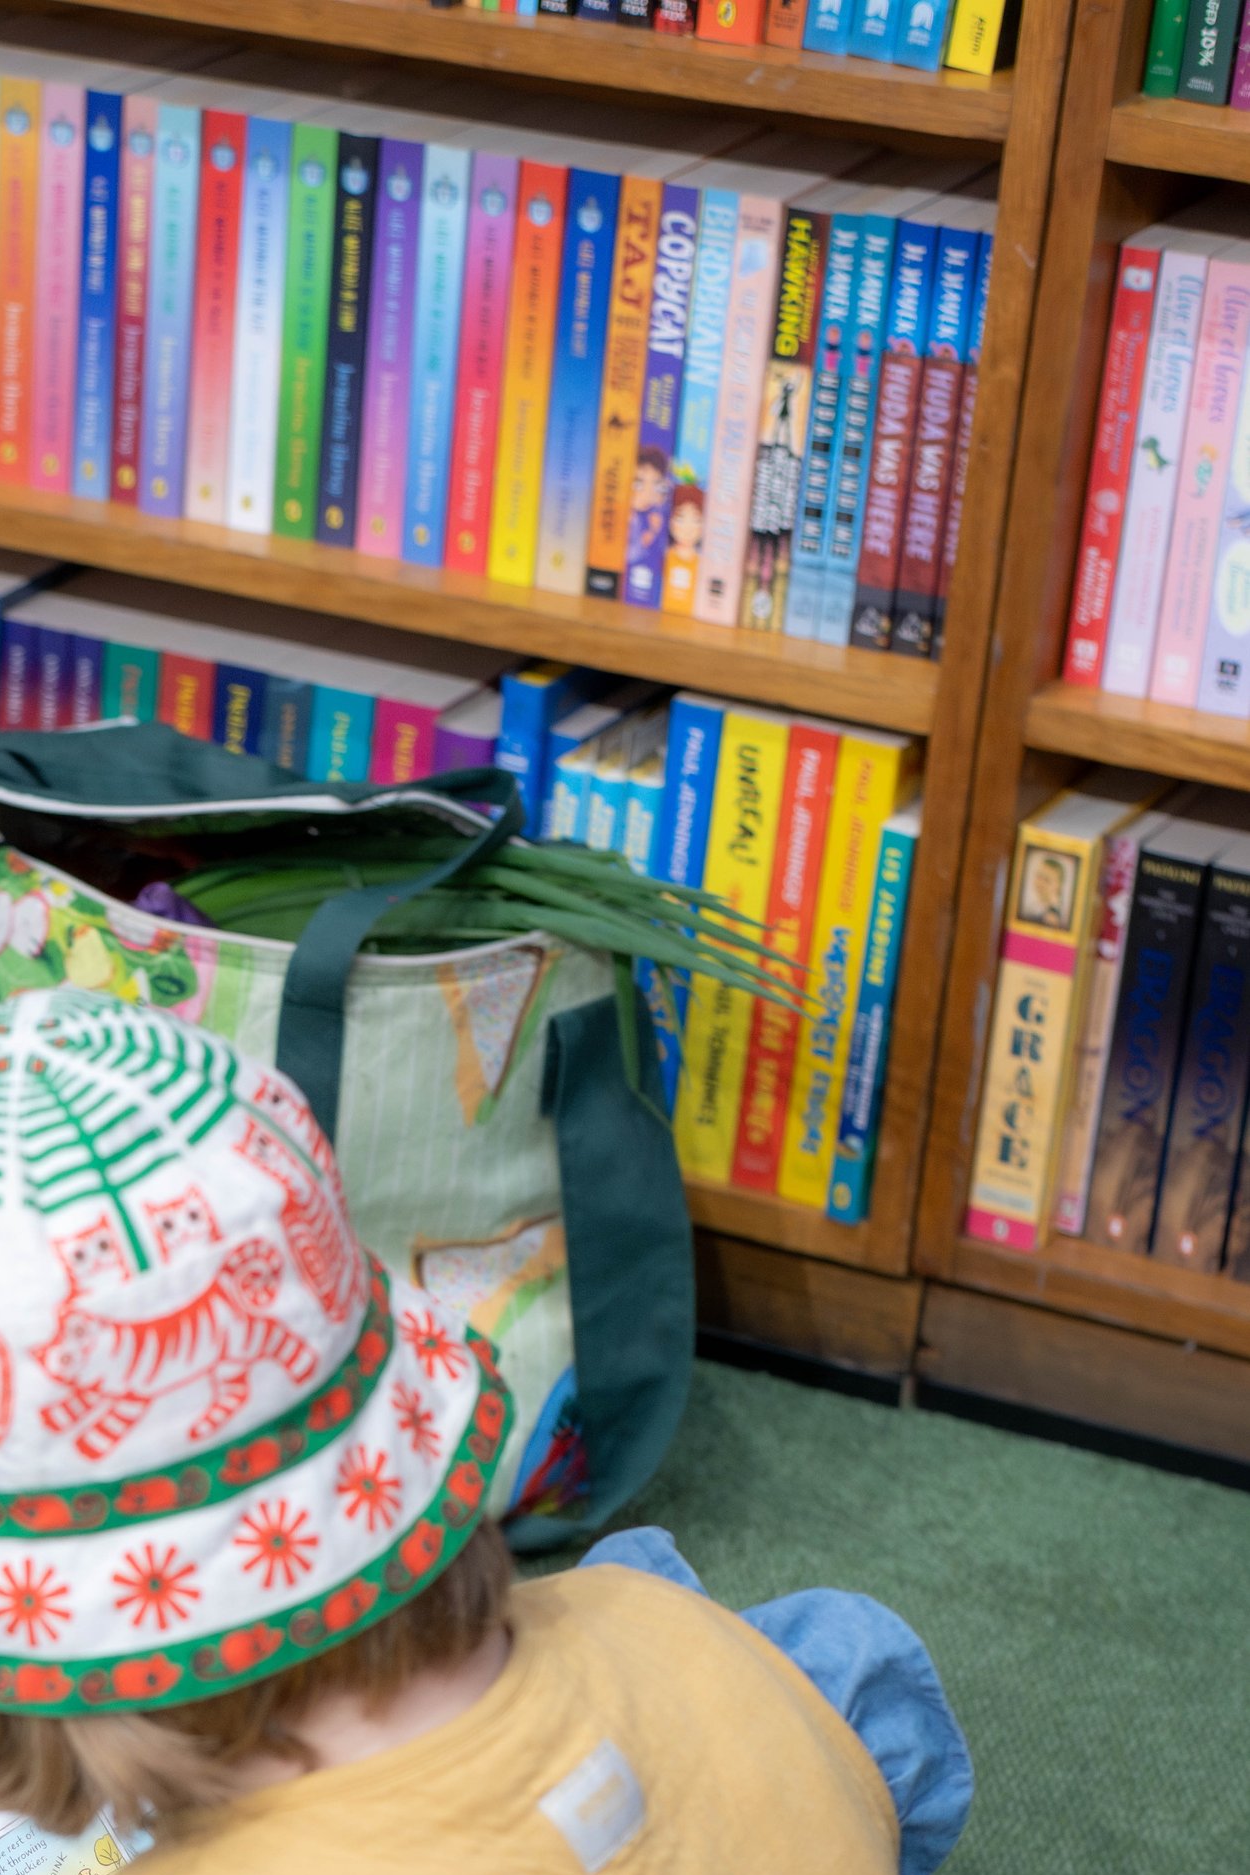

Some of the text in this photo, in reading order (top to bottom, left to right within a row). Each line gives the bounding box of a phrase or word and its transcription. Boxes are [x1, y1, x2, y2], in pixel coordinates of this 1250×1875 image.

[620, 200, 650, 309] TAJ
[648, 211, 697, 360] COPYCAT
[686, 204, 735, 387] BIRDBRAIN
[775, 217, 812, 357] HAWKING
[813, 370, 840, 438] HUDA
[844, 376, 871, 443] HUDA
[865, 363, 912, 558] HUDA WAS HERE
[906, 370, 955, 563] HUDA WAS HERE
[996, 994, 1049, 1170] GRACE
[1119, 946, 1174, 1127] ERAGON
[1193, 962, 1245, 1141] ERAGON
[7, 1835, 25, 1853] rest
[7, 1839, 49, 1868] throwing
